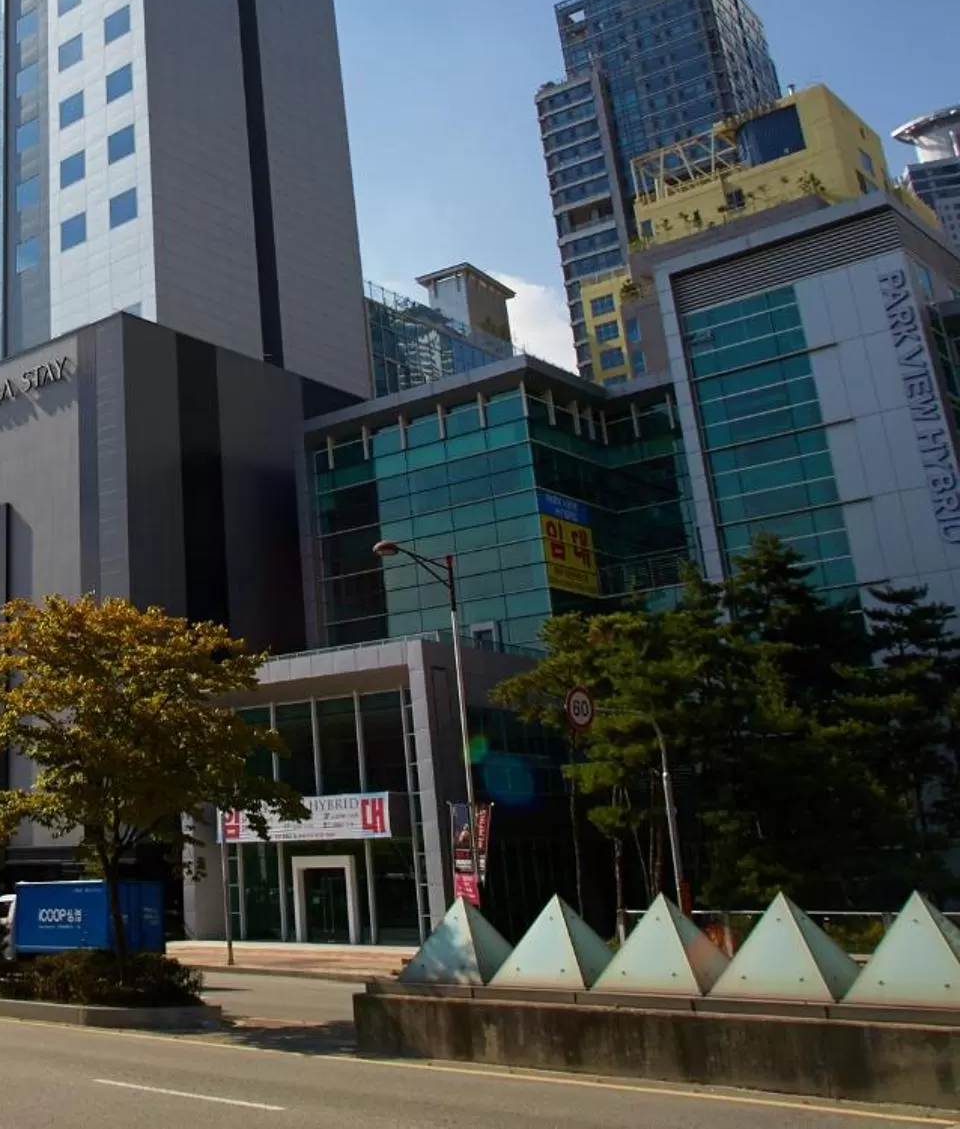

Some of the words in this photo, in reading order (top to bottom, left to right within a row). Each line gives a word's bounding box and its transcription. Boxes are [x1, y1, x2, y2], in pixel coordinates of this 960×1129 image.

[879, 268, 920, 349] PARK
[22, 356, 68, 393] STAY
[898, 344, 940, 422] VIEW
[573, 700, 589, 716] 60
[310, 798, 359, 811] HYBRID
[360, 798, 386, 833] 대
